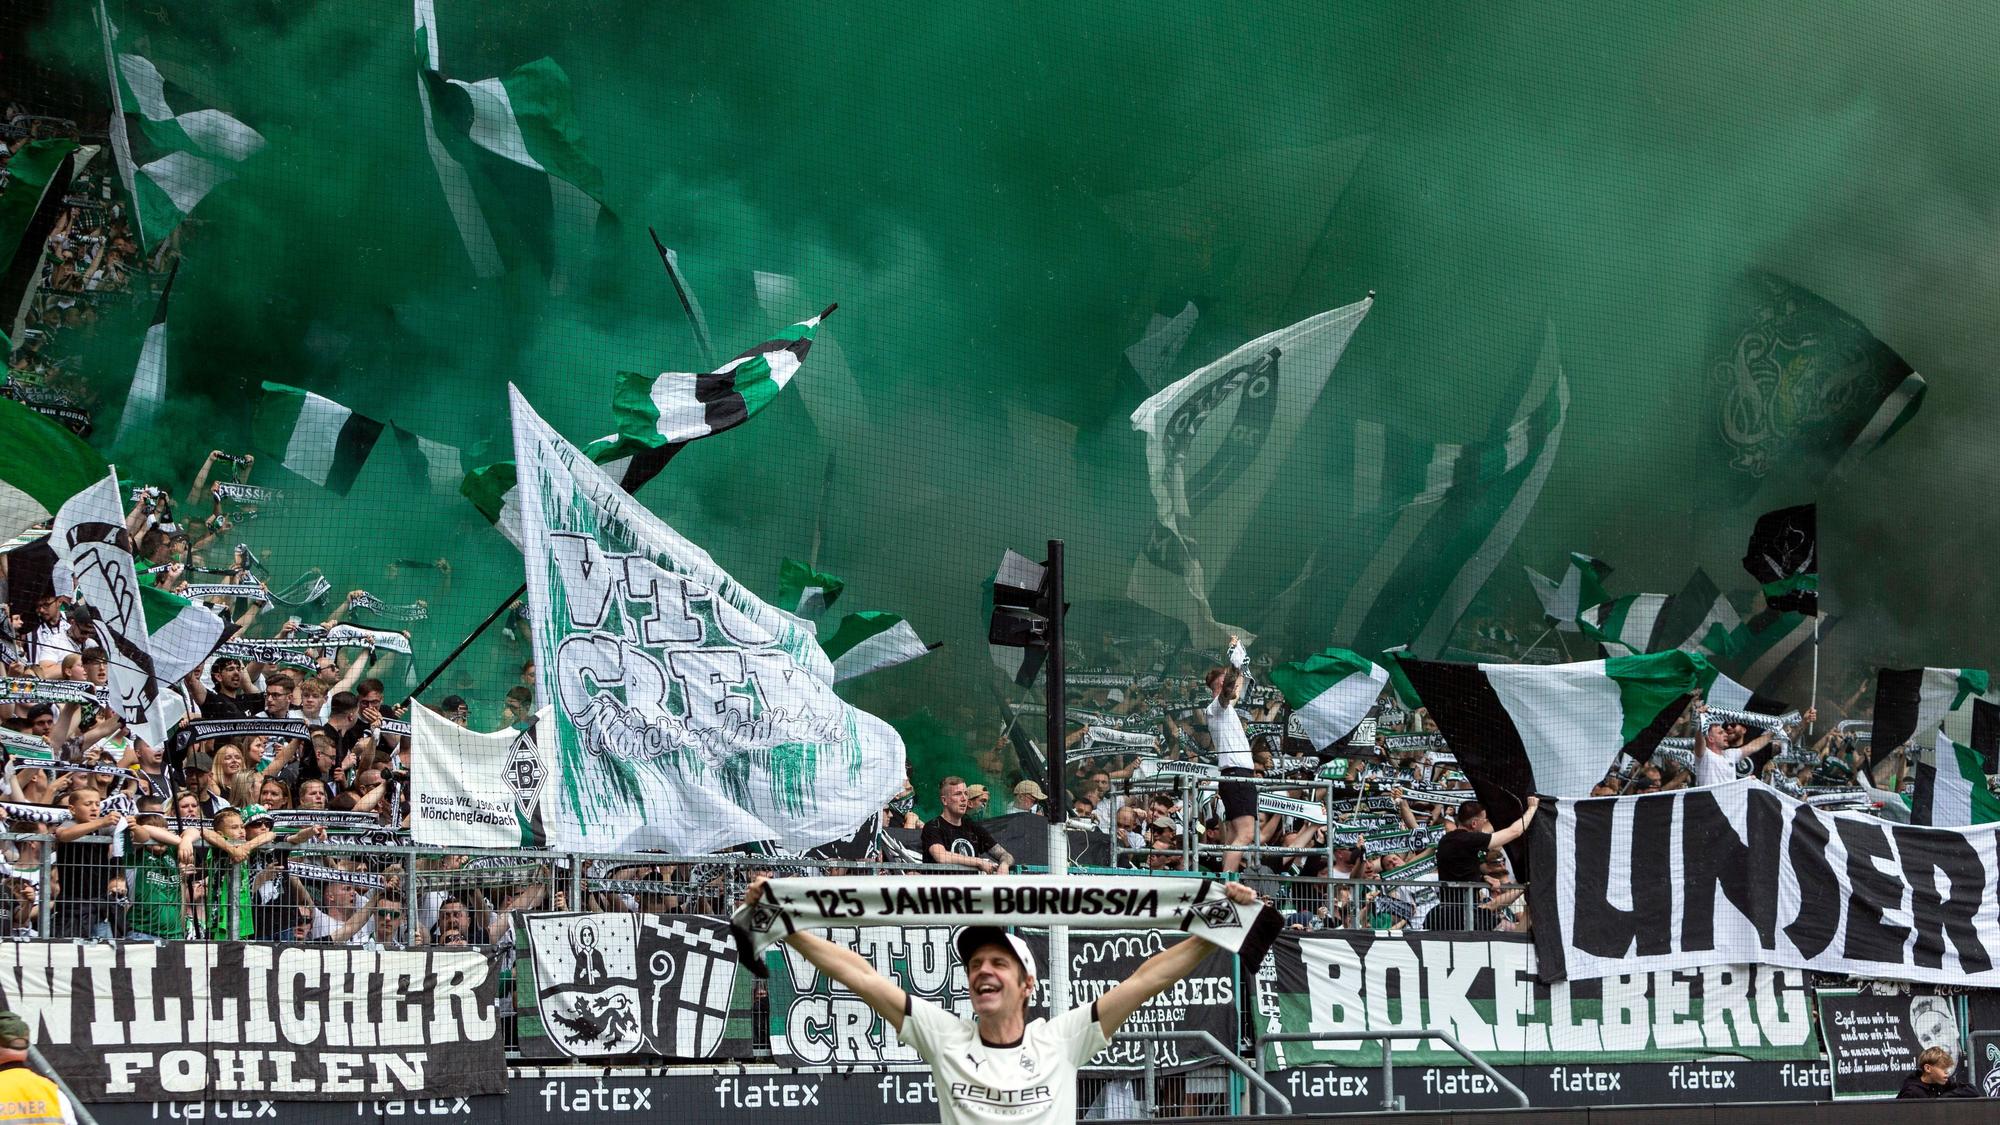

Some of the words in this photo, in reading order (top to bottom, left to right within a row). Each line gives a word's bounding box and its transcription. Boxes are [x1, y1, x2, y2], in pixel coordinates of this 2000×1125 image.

[420, 793, 454, 806] Borussia
[456, 796, 472, 807] VfL
[496, 802, 513, 813] e.V.
[420, 806, 517, 826] Mönchengladbach
[1573, 788, 2000, 975] UNSER
[805, 887, 865, 918] 125
[878, 886, 983, 915] JAHRE
[993, 886, 1158, 918] BORUSSIA
[0, 942, 497, 1047] WILLICHER
[1300, 937, 1811, 1052] BOKELBERG
[1834, 1010, 1856, 1030] Egal
[1856, 1015, 1871, 1025] was
[1871, 1011, 1885, 1025] wir
[1885, 1011, 1900, 1024] tun
[1841, 1026, 1858, 1042] und
[1870, 1028, 1883, 1040] wir
[1838, 1045, 1850, 1058] in
[105, 1049, 428, 1093] FOHLEN
[1668, 1065, 1736, 1089] flatex
[1780, 1063, 1831, 1087] flate
[1853, 1058, 1864, 1073] du
[1864, 1059, 1889, 1073] immer
[878, 1075, 939, 1104] flat
[1287, 1070, 1369, 1097] flatex
[1549, 1067, 1621, 1092] flatex
[540, 1081, 652, 1112] flatex
[714, 1078, 819, 1108] flatex
[951, 1082, 1051, 1103] REUTER
